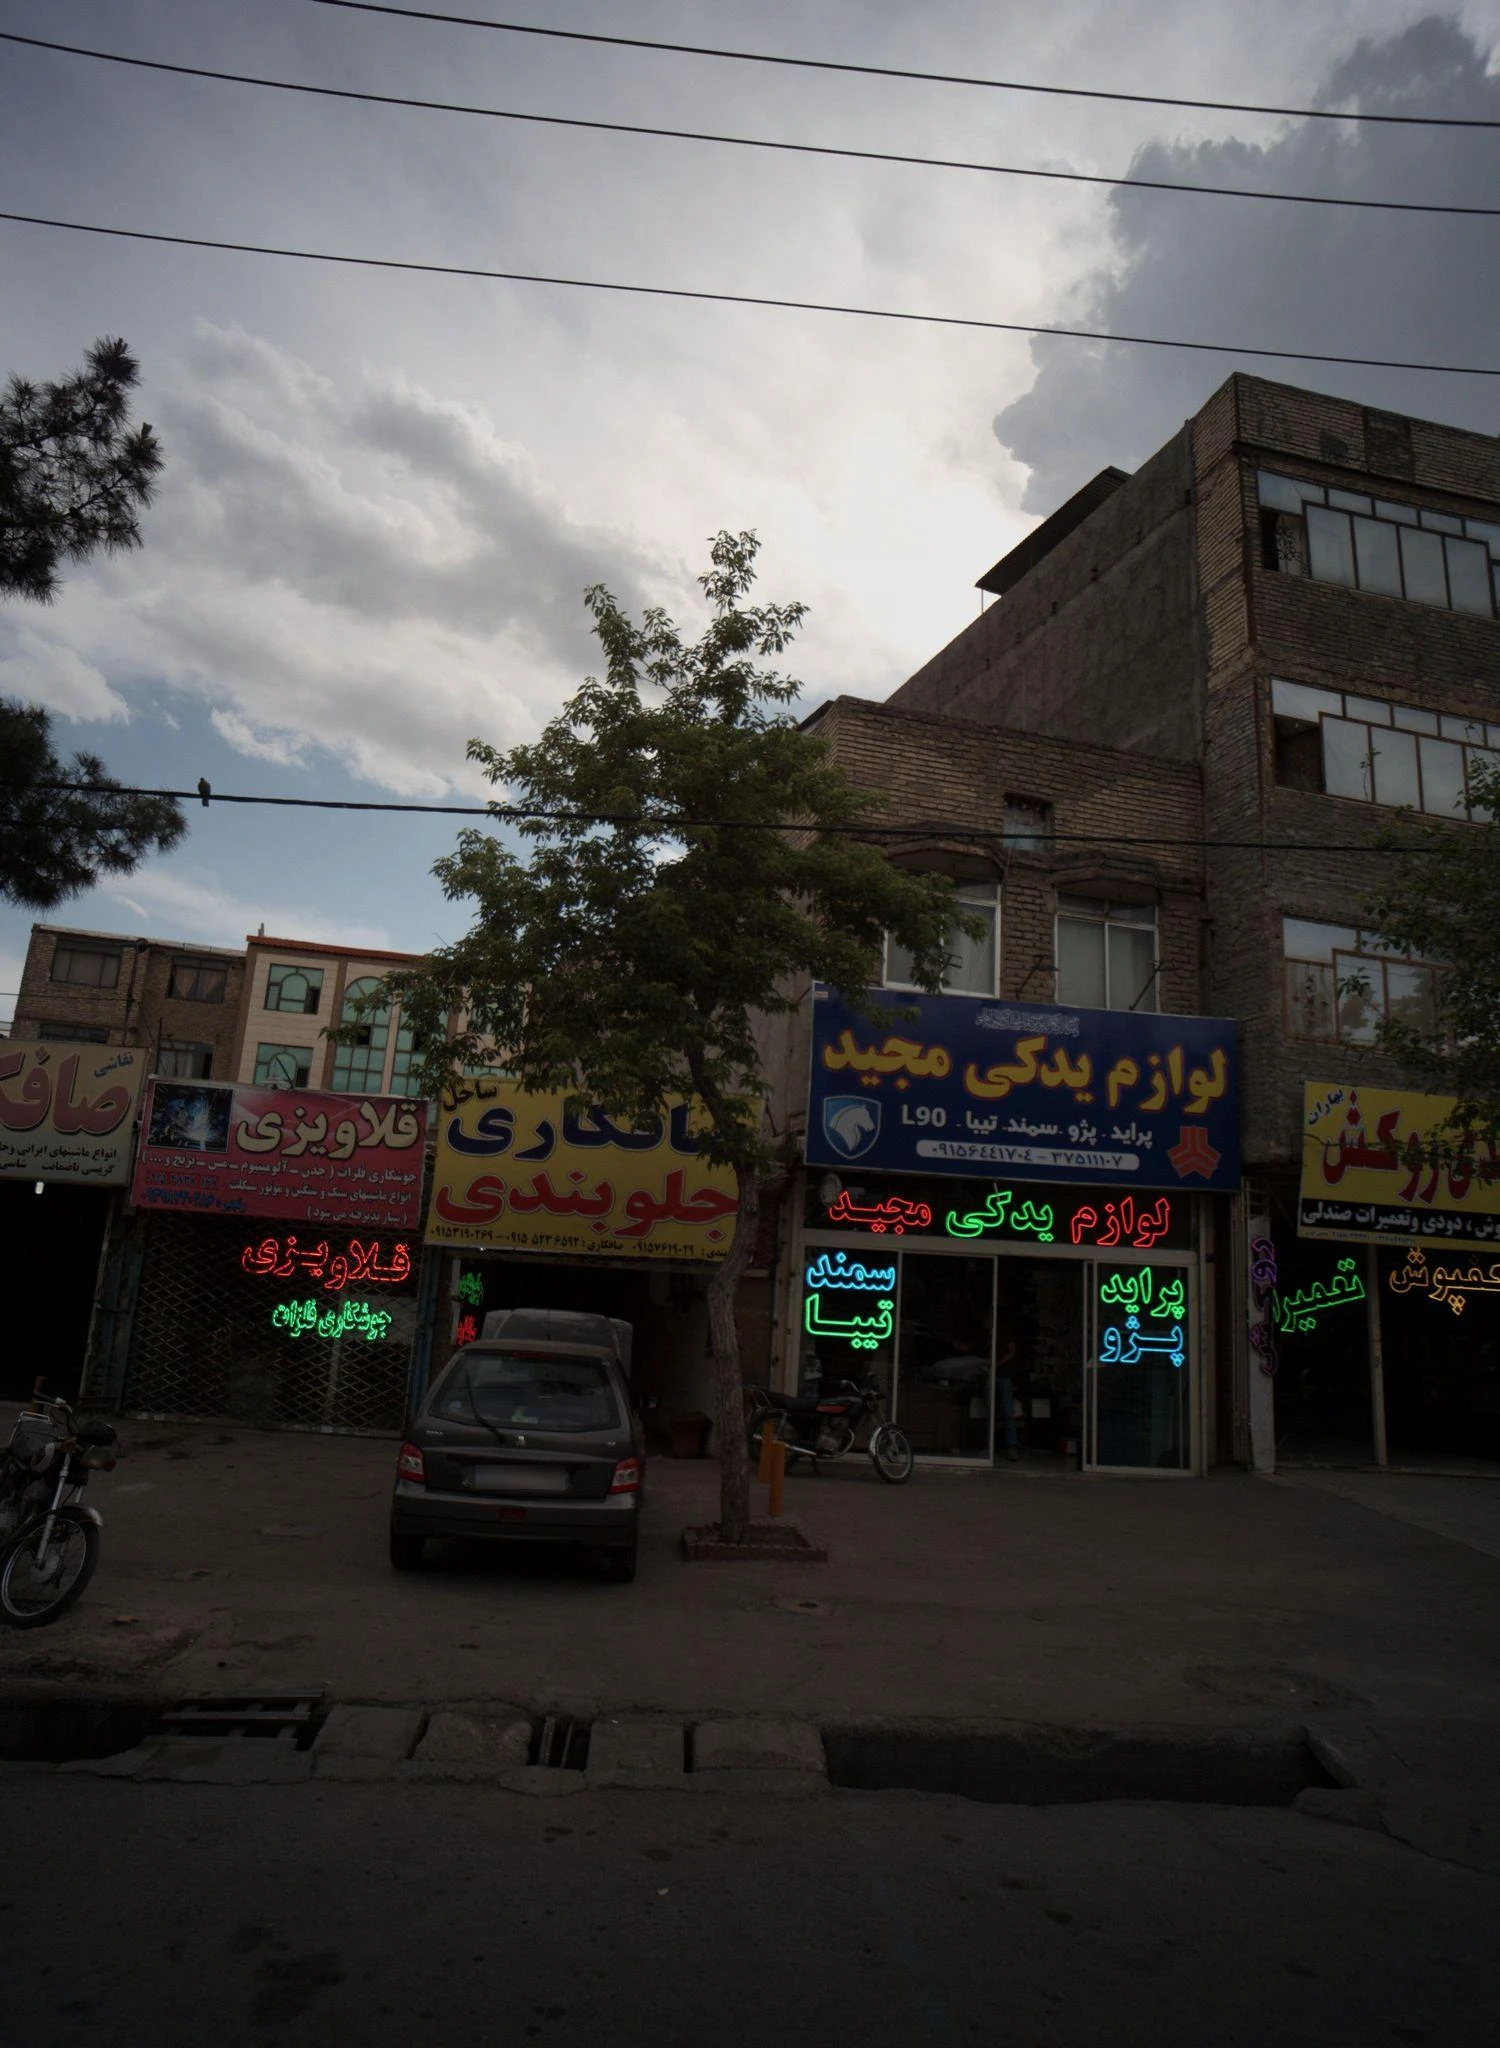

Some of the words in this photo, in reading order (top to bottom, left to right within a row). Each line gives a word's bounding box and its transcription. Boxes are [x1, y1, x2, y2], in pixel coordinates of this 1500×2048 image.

[94, 1051, 133, 1077] نقاشی
[822, 1028, 952, 1092] مجید
[963, 1034, 1094, 1103] یدکی
[1105, 1044, 1230, 1116] لوازم
[443, 1080, 497, 1111] ساحل
[902, 1104, 947, 1128] L90
[236, 1101, 419, 1160] قلاویزی
[965, 1110, 998, 1135] تیبا
[1008, 1116, 1058, 1137] سمند
[1067, 1119, 1098, 1146] پژو
[1110, 1122, 1153, 1149] پراید
[337, 1164, 366, 1182] فلزات
[368, 1168, 417, 1185] جوشکاری
[827, 1190, 933, 1235] مجید
[945, 1191, 1055, 1242] یدکی
[1070, 1196, 1171, 1248] لوازم
[1302, 1200, 1352, 1225] صندلی
[1422, 1215, 1463, 1236] دودی
[241, 1235, 412, 1290] قلاویزی
[805, 1251, 896, 1292] سمند
[1101, 1266, 1186, 1319] پراید
[804, 1293, 895, 1351] تیبا
[1099, 1315, 1186, 1367] پژو
